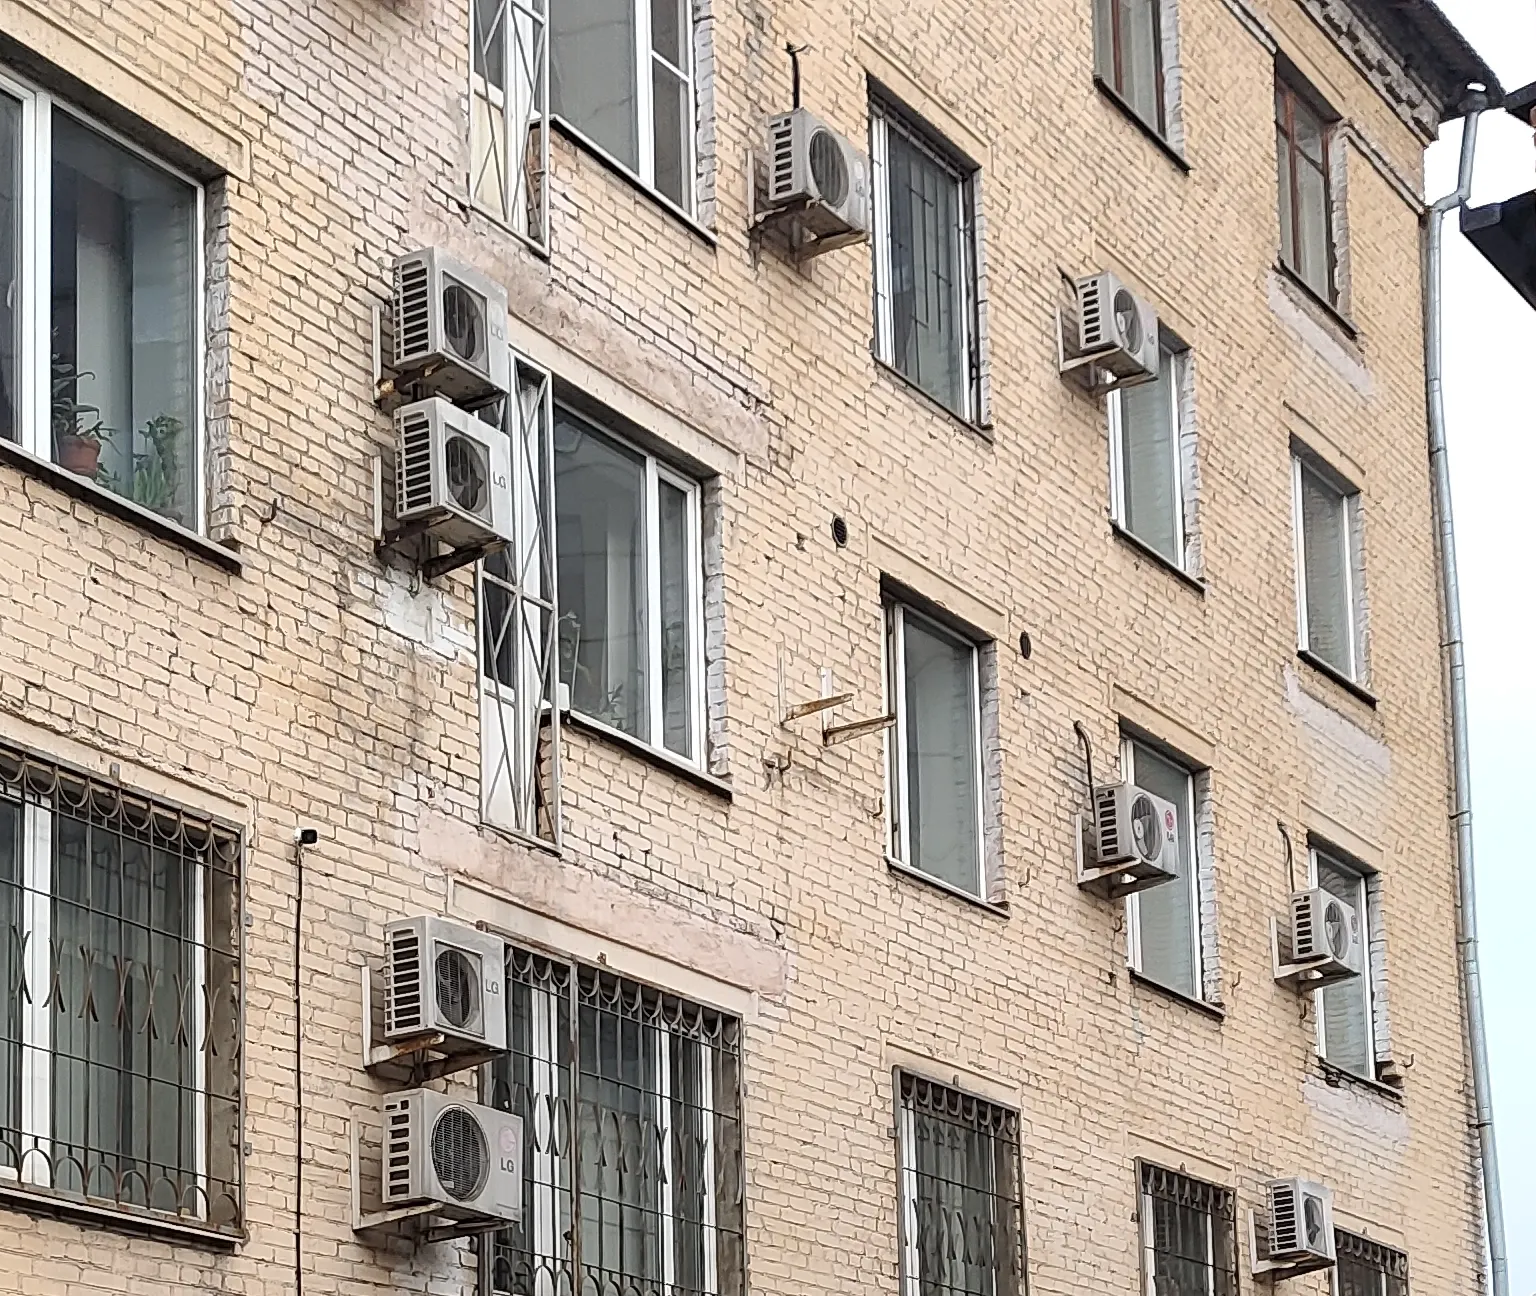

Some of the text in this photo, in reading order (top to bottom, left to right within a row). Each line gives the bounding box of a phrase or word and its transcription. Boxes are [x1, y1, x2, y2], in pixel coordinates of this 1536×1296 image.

[492, 470, 507, 490] LG
[485, 979, 500, 996] LG
[500, 1156, 515, 1174] LG
